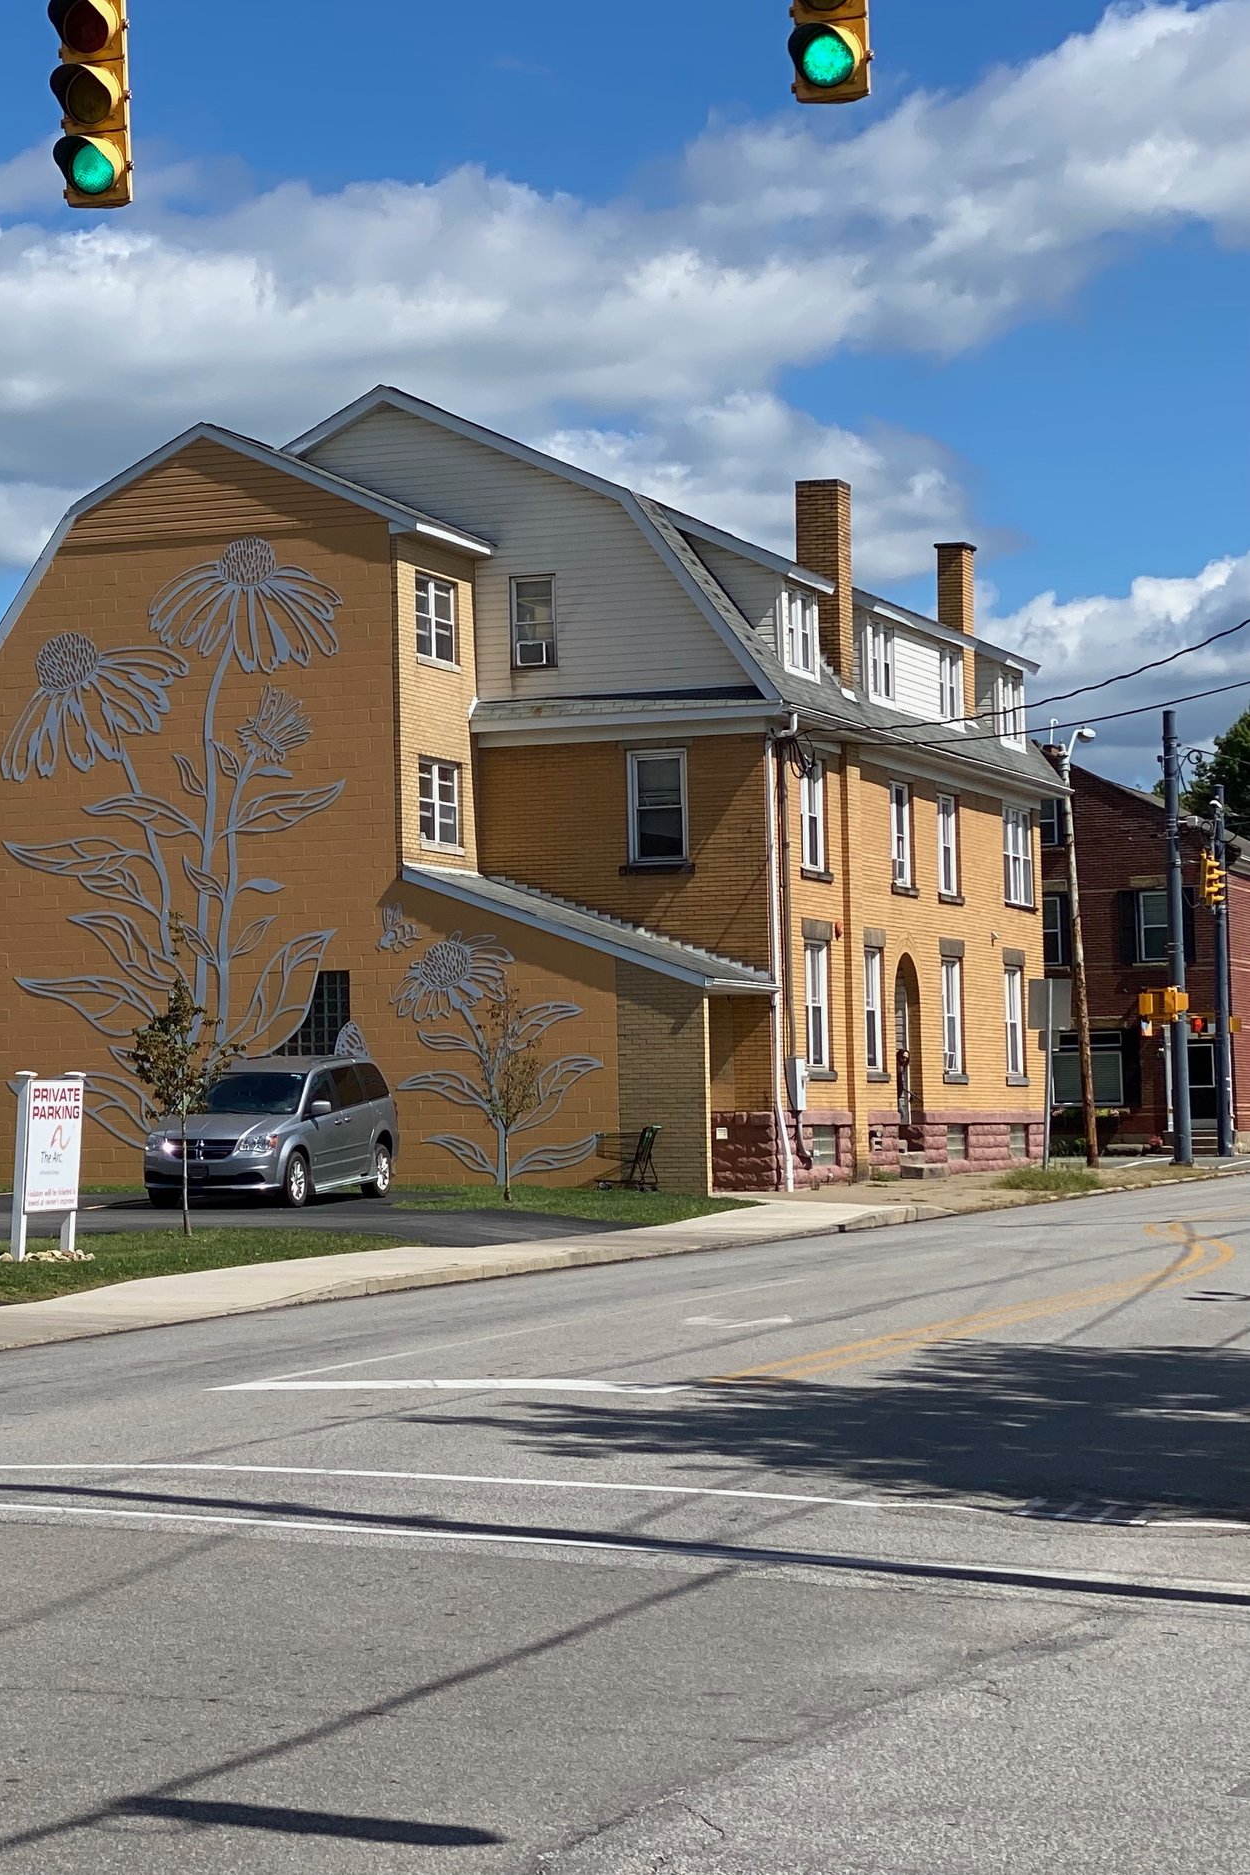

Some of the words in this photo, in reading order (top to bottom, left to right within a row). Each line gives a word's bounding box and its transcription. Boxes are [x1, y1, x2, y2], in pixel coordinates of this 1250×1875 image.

[33, 1088, 80, 1102] PRIVATE
[32, 1105, 80, 1120] PARKING
[41, 1151, 51, 1164] The
[52, 1151, 63, 1163] Arc
